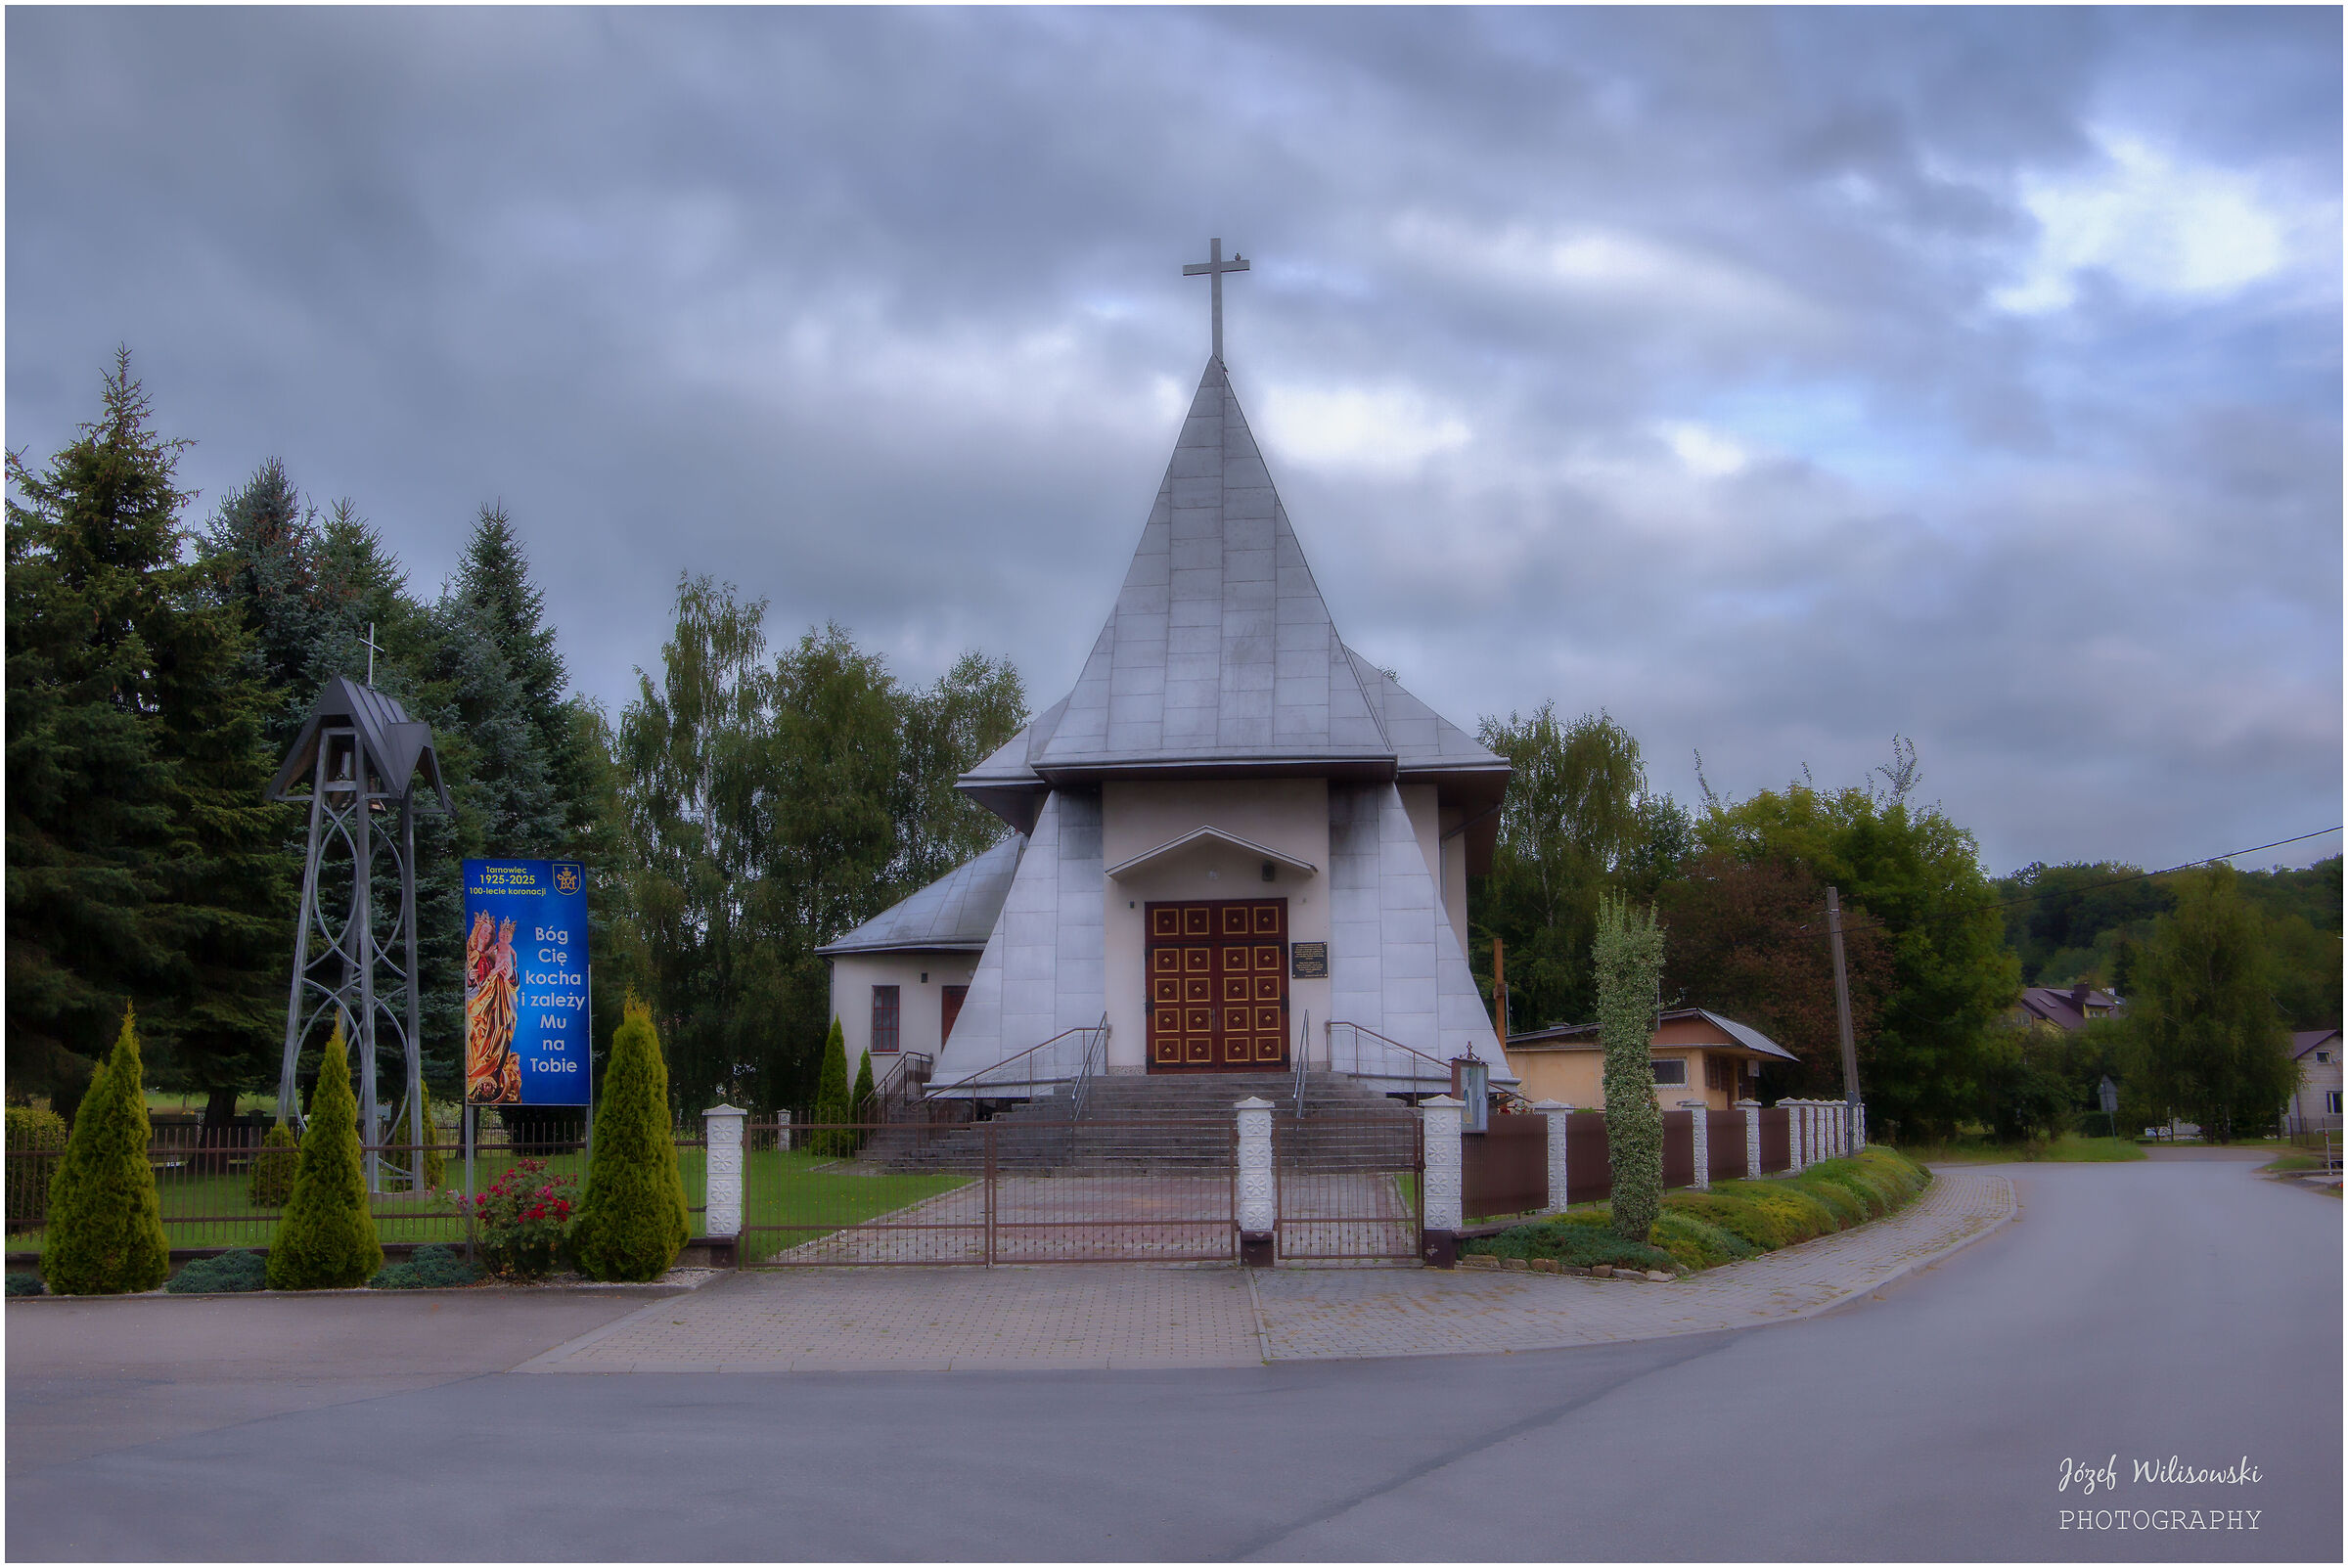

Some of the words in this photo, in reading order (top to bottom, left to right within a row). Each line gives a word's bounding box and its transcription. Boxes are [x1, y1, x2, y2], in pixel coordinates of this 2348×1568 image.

[479, 874, 536, 884] 1925-2025
[508, 887, 547, 896] koronacji
[535, 925, 568, 945] Bóg
[538, 948, 567, 966] Cię
[525, 969, 581, 985] kocha
[521, 991, 525, 1007] i
[530, 992, 586, 1010] zależy
[540, 1014, 566, 1029] Mu
[543, 1039, 565, 1052] na
[529, 1057, 578, 1073] Tobie
